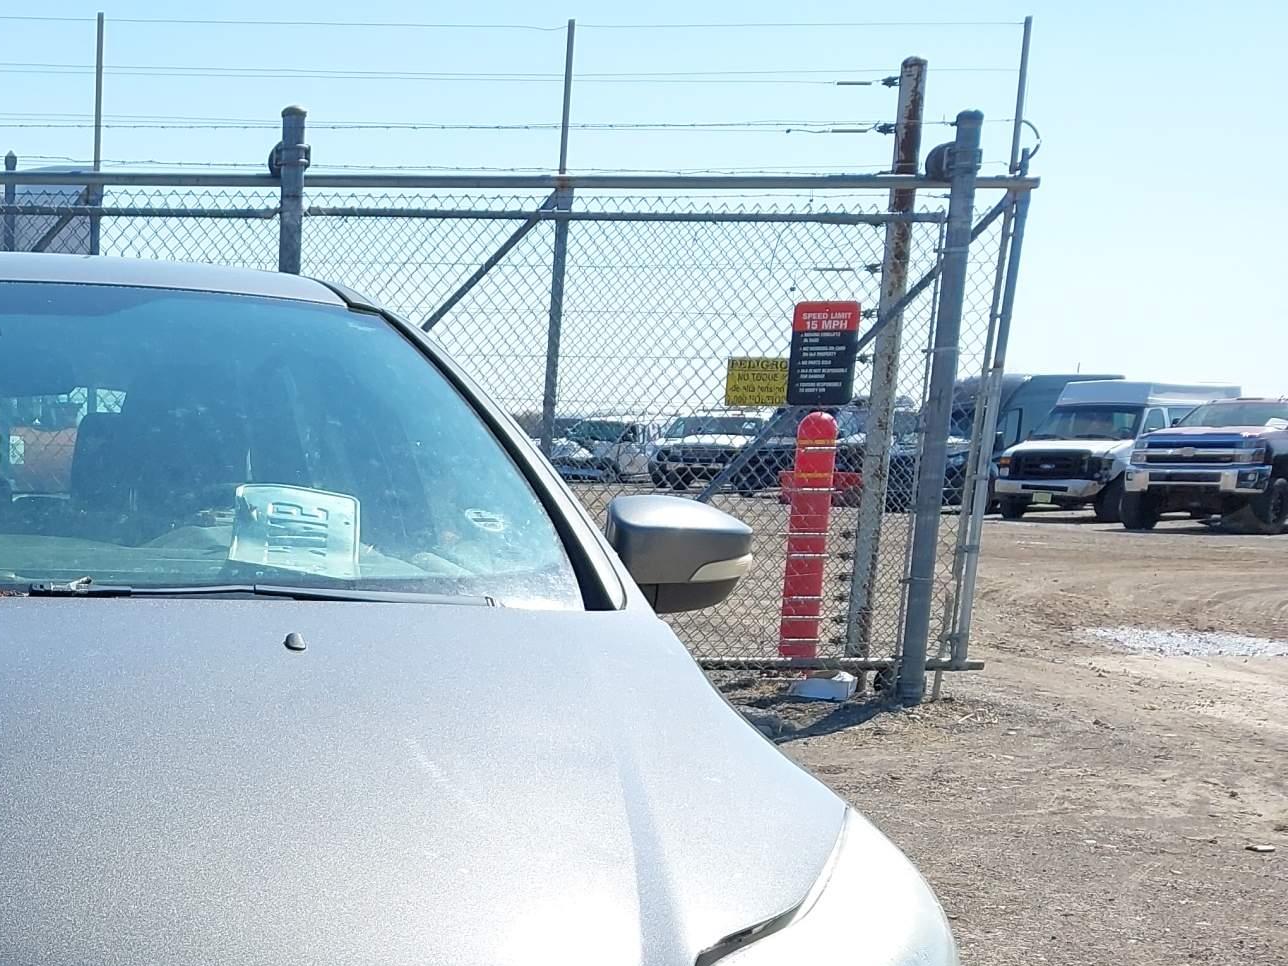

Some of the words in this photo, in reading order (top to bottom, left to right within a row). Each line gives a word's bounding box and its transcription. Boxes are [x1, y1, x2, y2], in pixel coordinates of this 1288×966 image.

[802, 312, 829, 320] SPEED
[830, 312, 852, 320] LIMIT
[805, 320, 818, 330] 15
[821, 320, 848, 330] MPH
